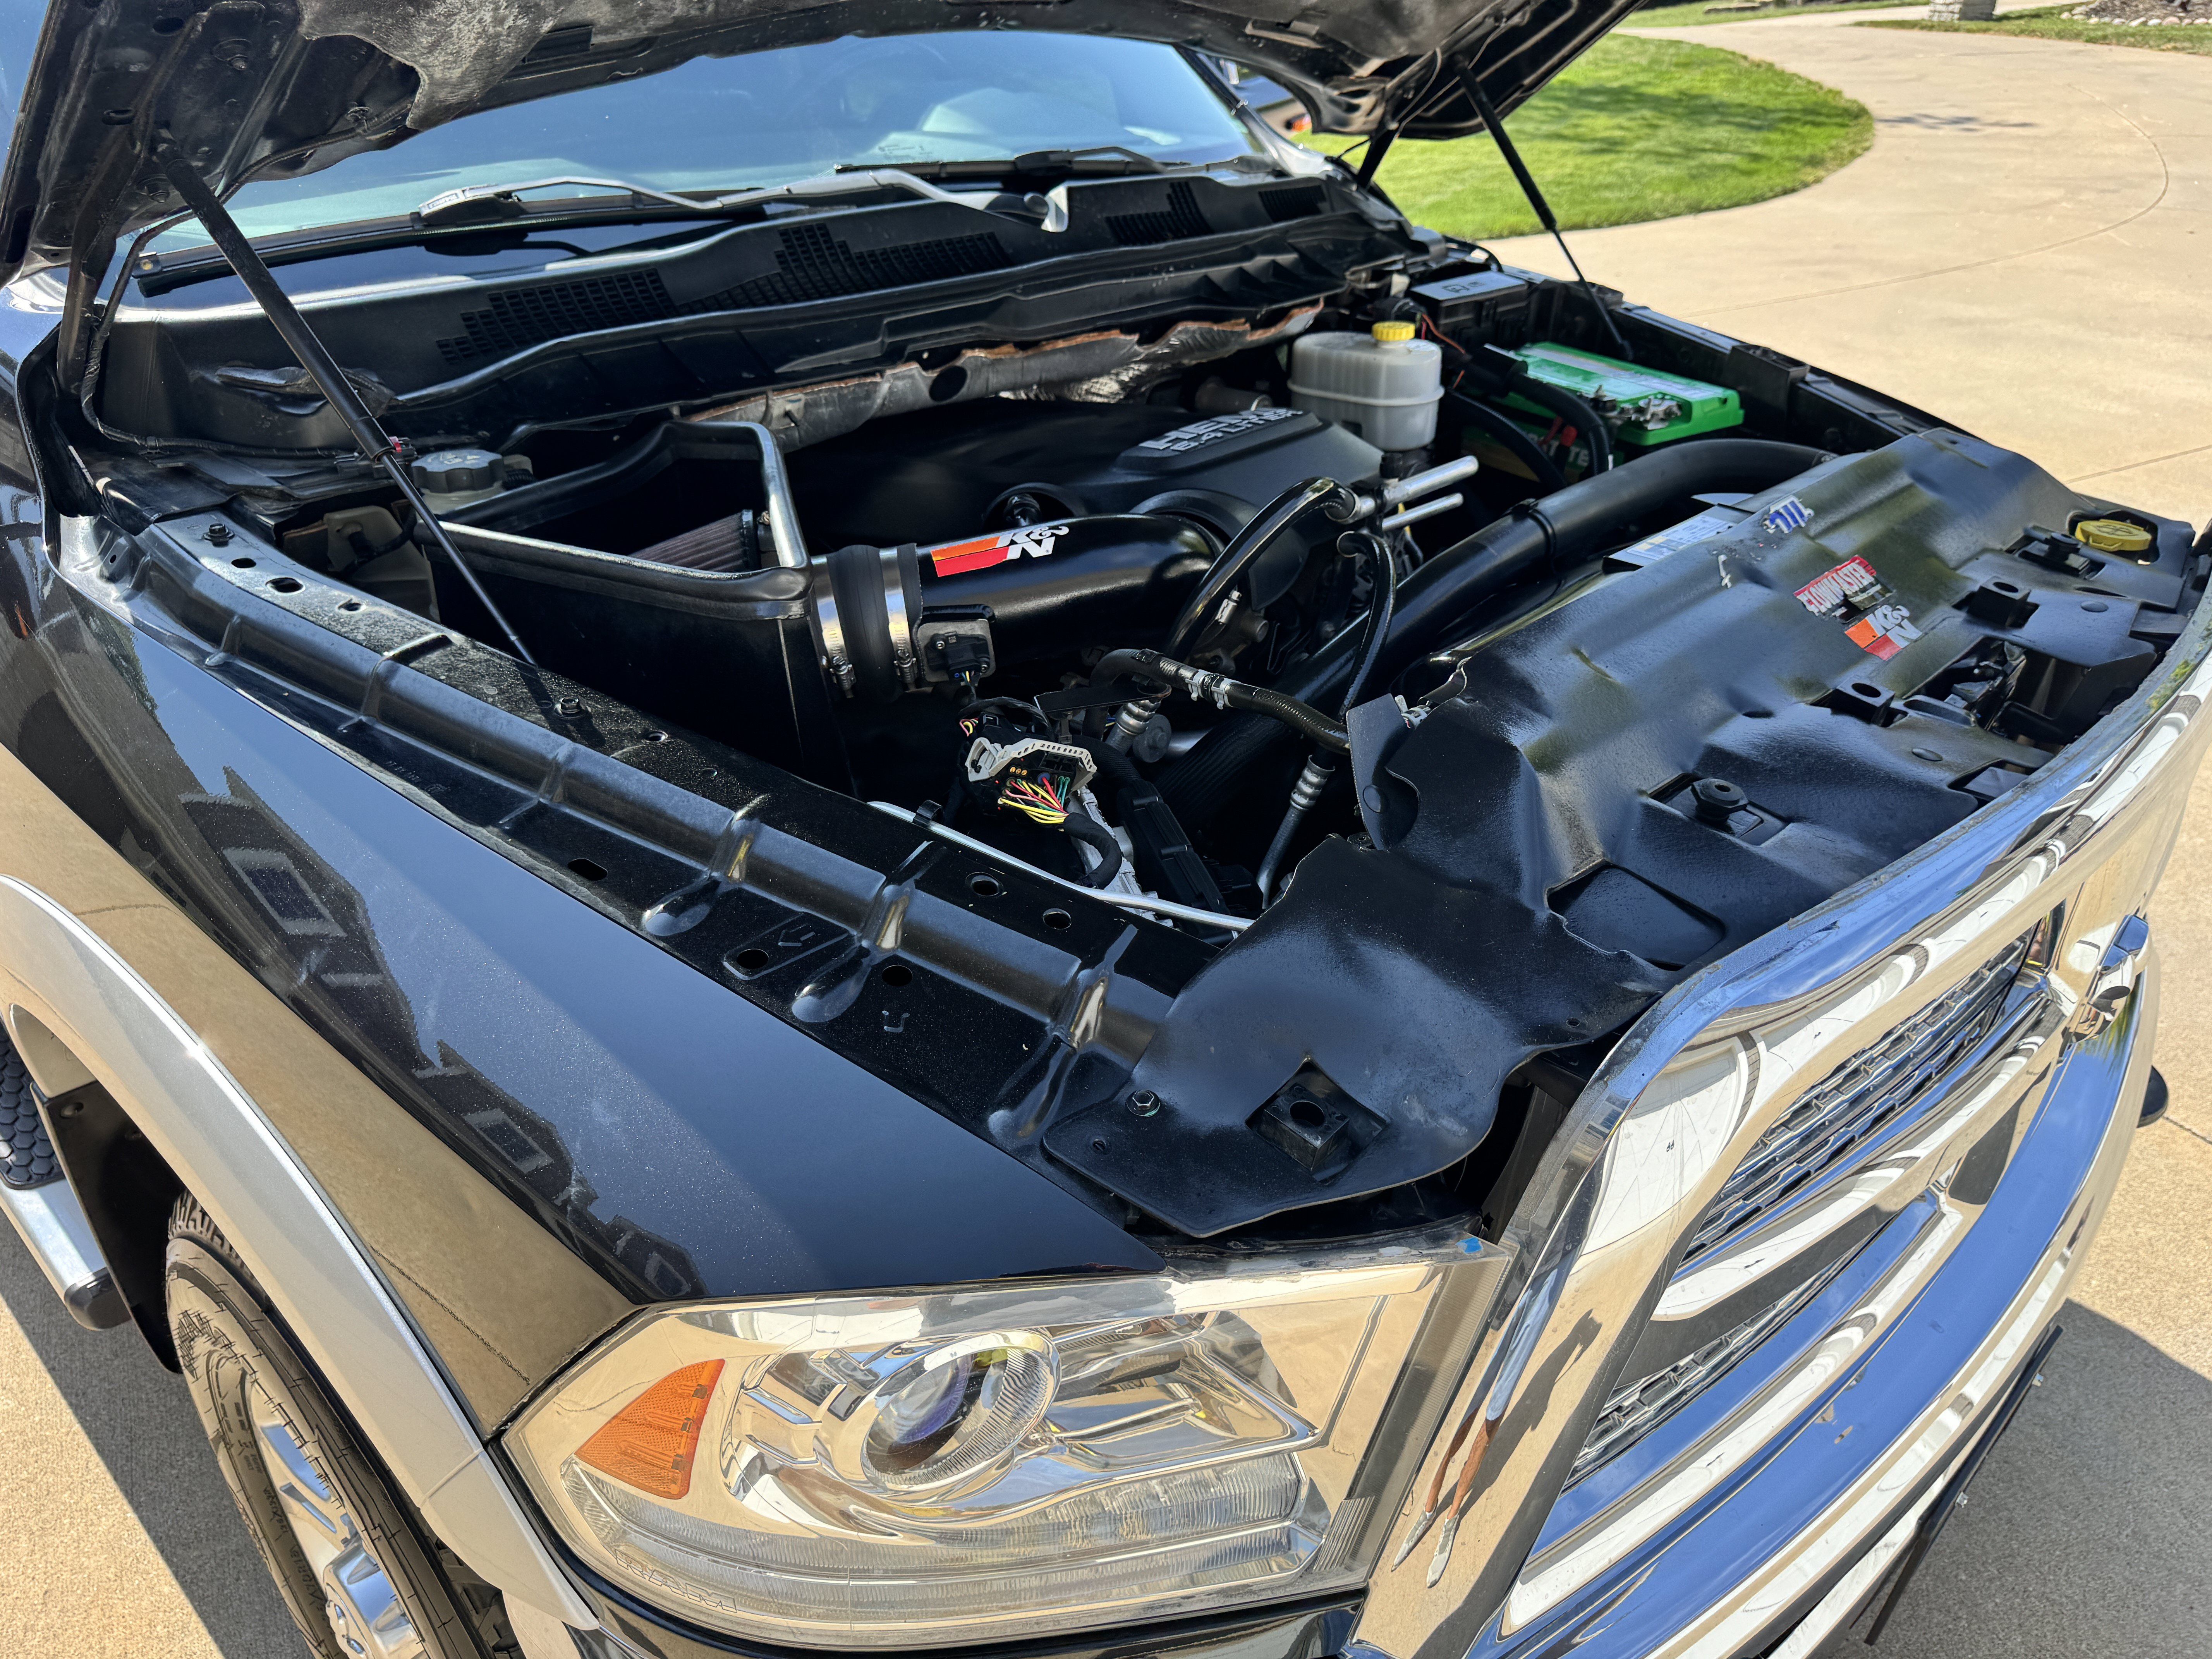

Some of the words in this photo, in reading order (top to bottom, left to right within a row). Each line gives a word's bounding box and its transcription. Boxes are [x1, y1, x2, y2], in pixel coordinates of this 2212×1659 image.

[1138, 407, 1287, 449] HEMI
[1170, 431, 1223, 451] 6.4
[996, 526, 1069, 560] K&N
[1796, 562, 1874, 616] FLOWMASTER
[1866, 605, 1922, 648] K&N
[615, 1549, 737, 1613] RAM
